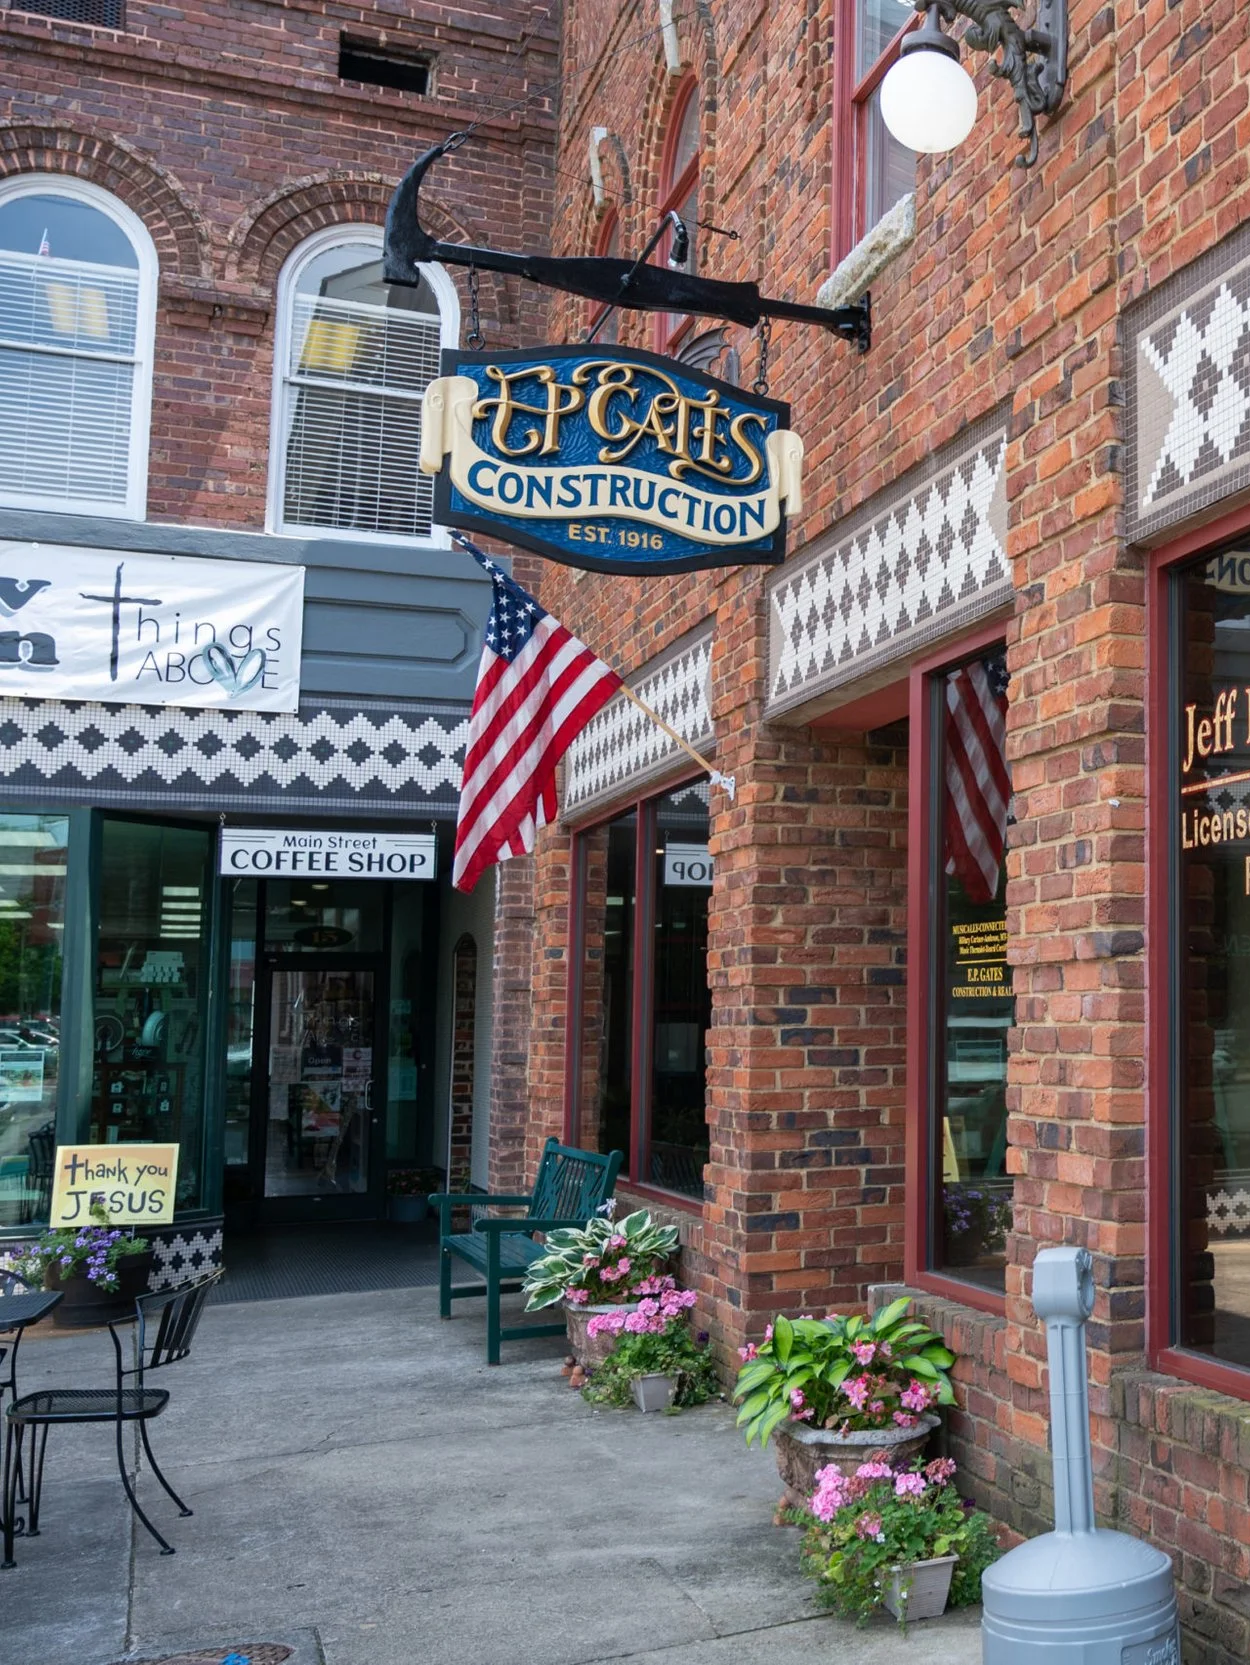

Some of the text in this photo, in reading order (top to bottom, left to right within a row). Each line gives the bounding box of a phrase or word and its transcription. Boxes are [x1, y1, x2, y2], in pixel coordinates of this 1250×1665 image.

[573, 361, 769, 486] GATES
[467, 460, 767, 537] CONSTRUCTION
[568, 523, 664, 550] EST. 1916
[1183, 688, 1238, 773] Jeff
[282, 835, 378, 850] Main Street
[230, 849, 427, 873] COFFEE SHOP
[980, 967, 1003, 982] GATES
[952, 986, 991, 998] CONSTRUCTION
[135, 1164, 168, 1187] you
